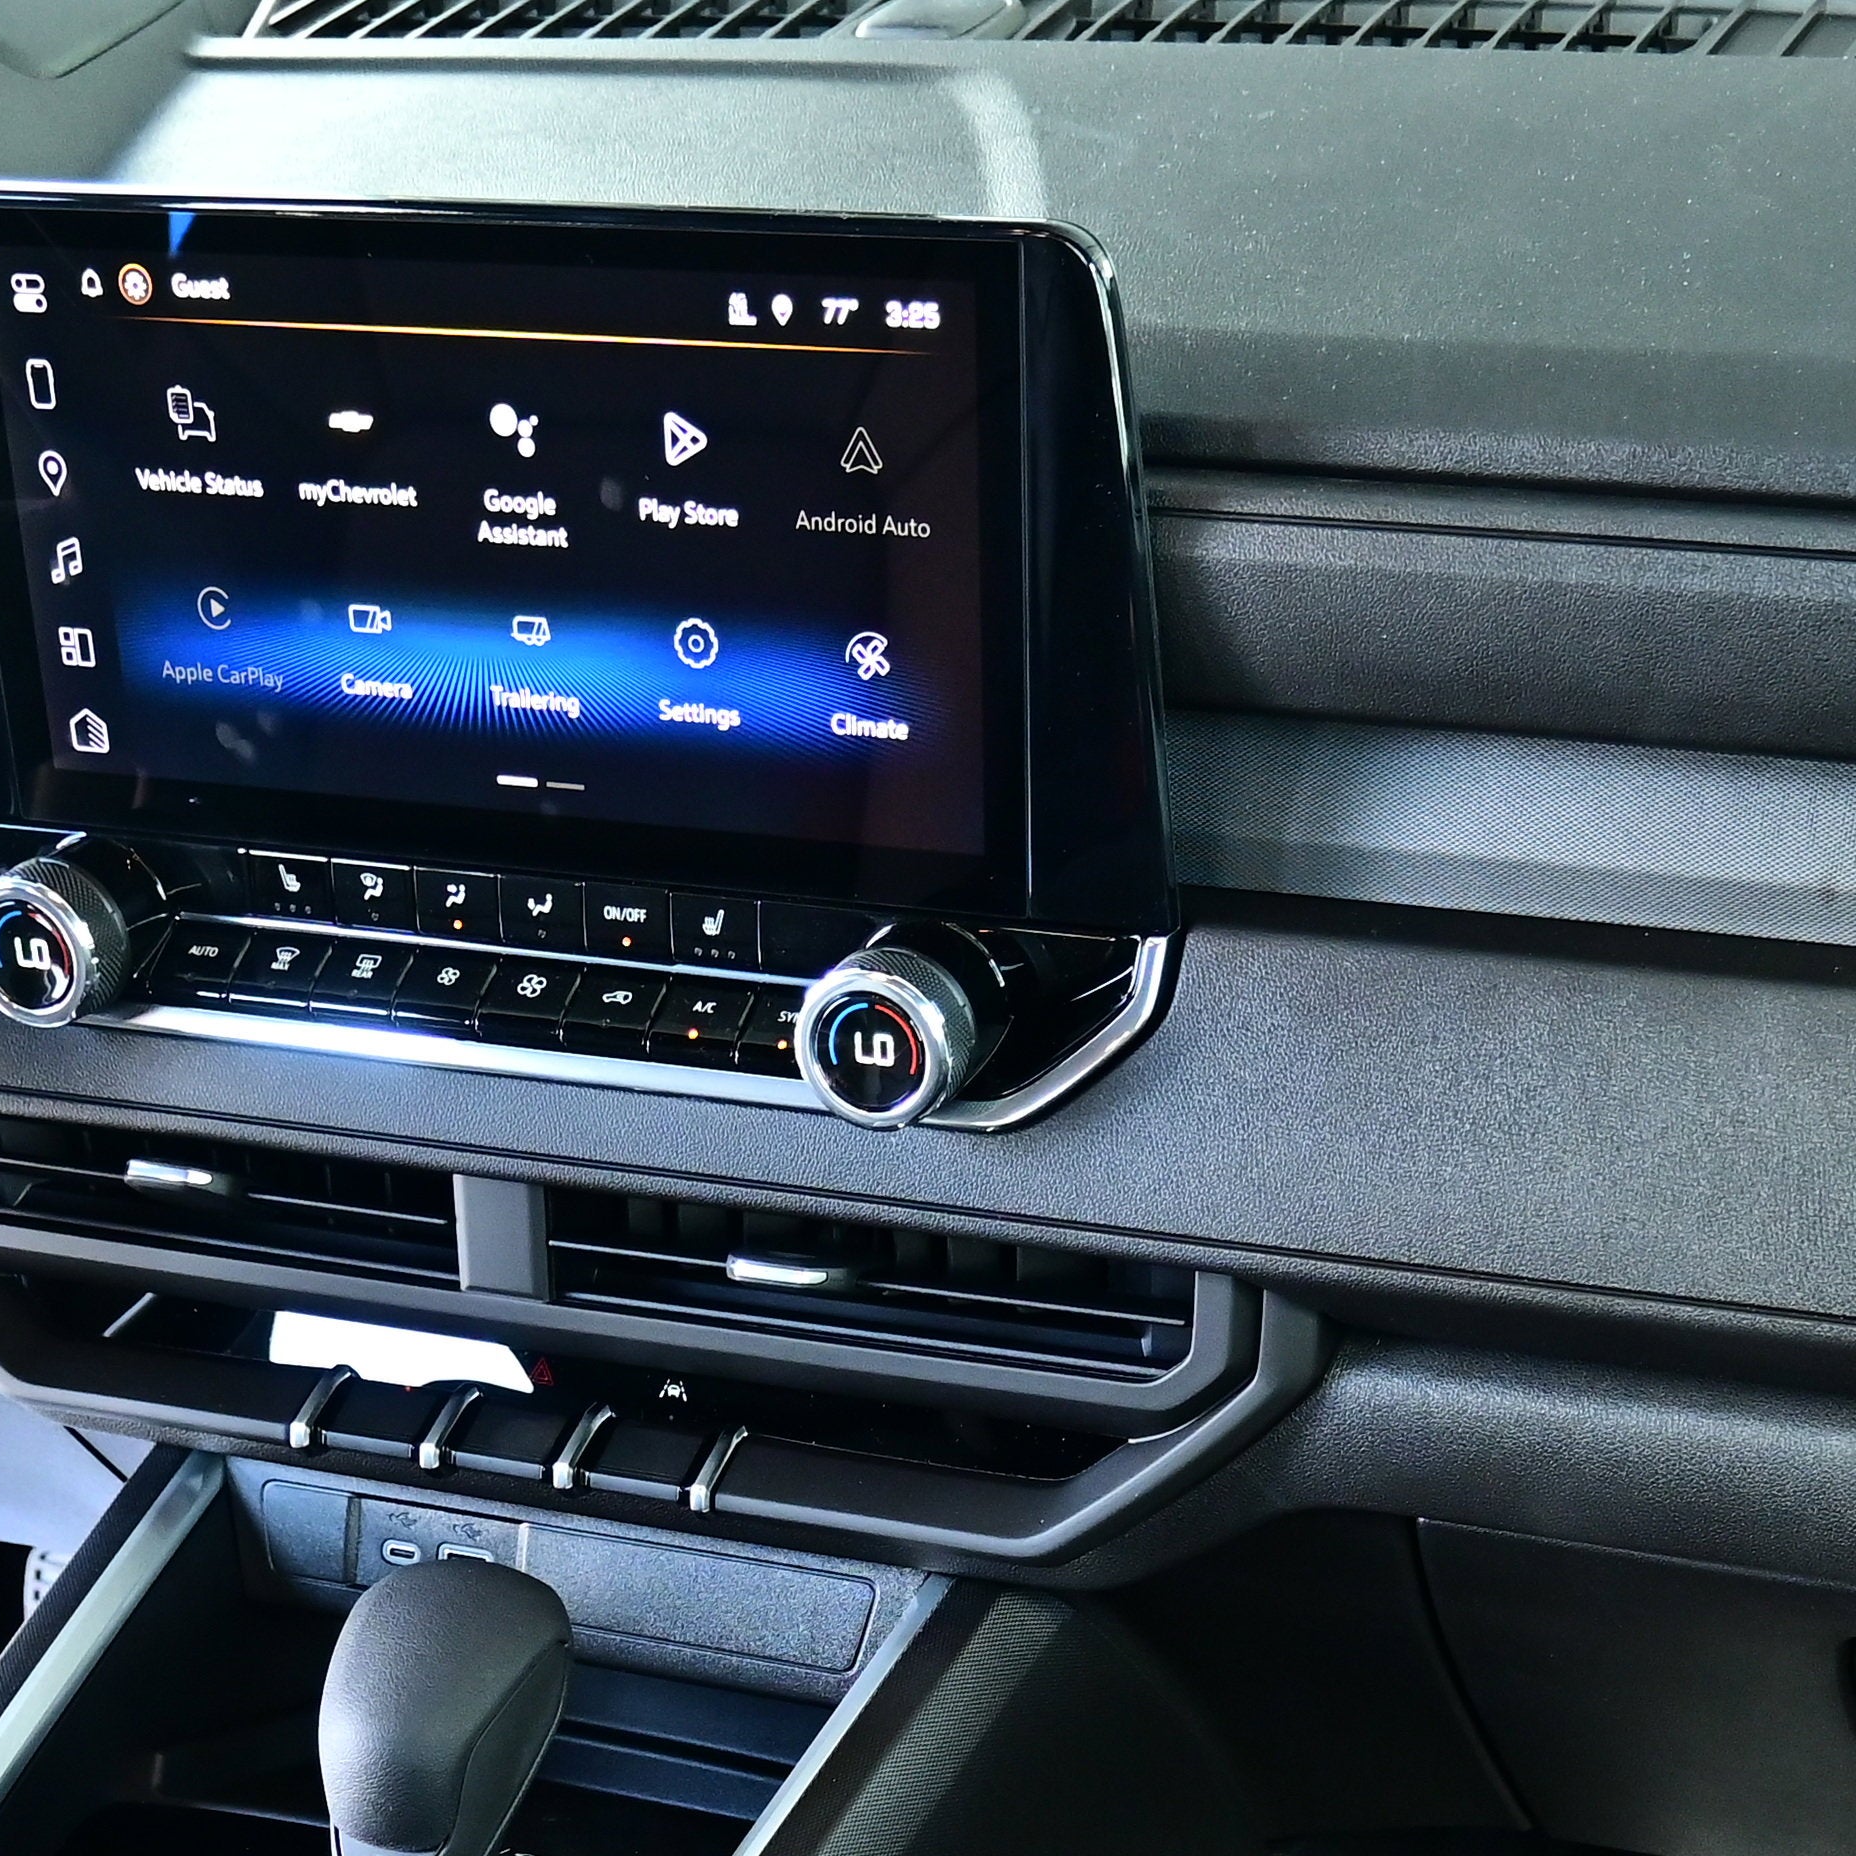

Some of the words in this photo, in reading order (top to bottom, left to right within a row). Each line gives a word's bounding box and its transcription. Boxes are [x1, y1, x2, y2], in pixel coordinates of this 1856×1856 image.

[170, 272, 232, 300] Guest
[885, 300, 941, 330] 3:25
[134, 467, 202, 494] Vehicle
[204, 471, 265, 498] Status
[298, 478, 419, 508] myChevrolet
[482, 487, 557, 520] Google
[638, 496, 681, 529] Play
[684, 500, 740, 528] Store
[477, 519, 569, 549] Assistant
[795, 509, 877, 536] Android
[882, 514, 931, 539] Auto
[162, 659, 214, 686] Apple
[217, 664, 284, 693] CarPlay
[340, 673, 414, 700] Camera
[490, 684, 581, 719] Trailering
[658, 698, 742, 732] Settings
[830, 712, 910, 741] Climate
[603, 905, 647, 923] ON/OFF
[188, 945, 219, 957] AUTO
[692, 1000, 717, 1014] A/C
